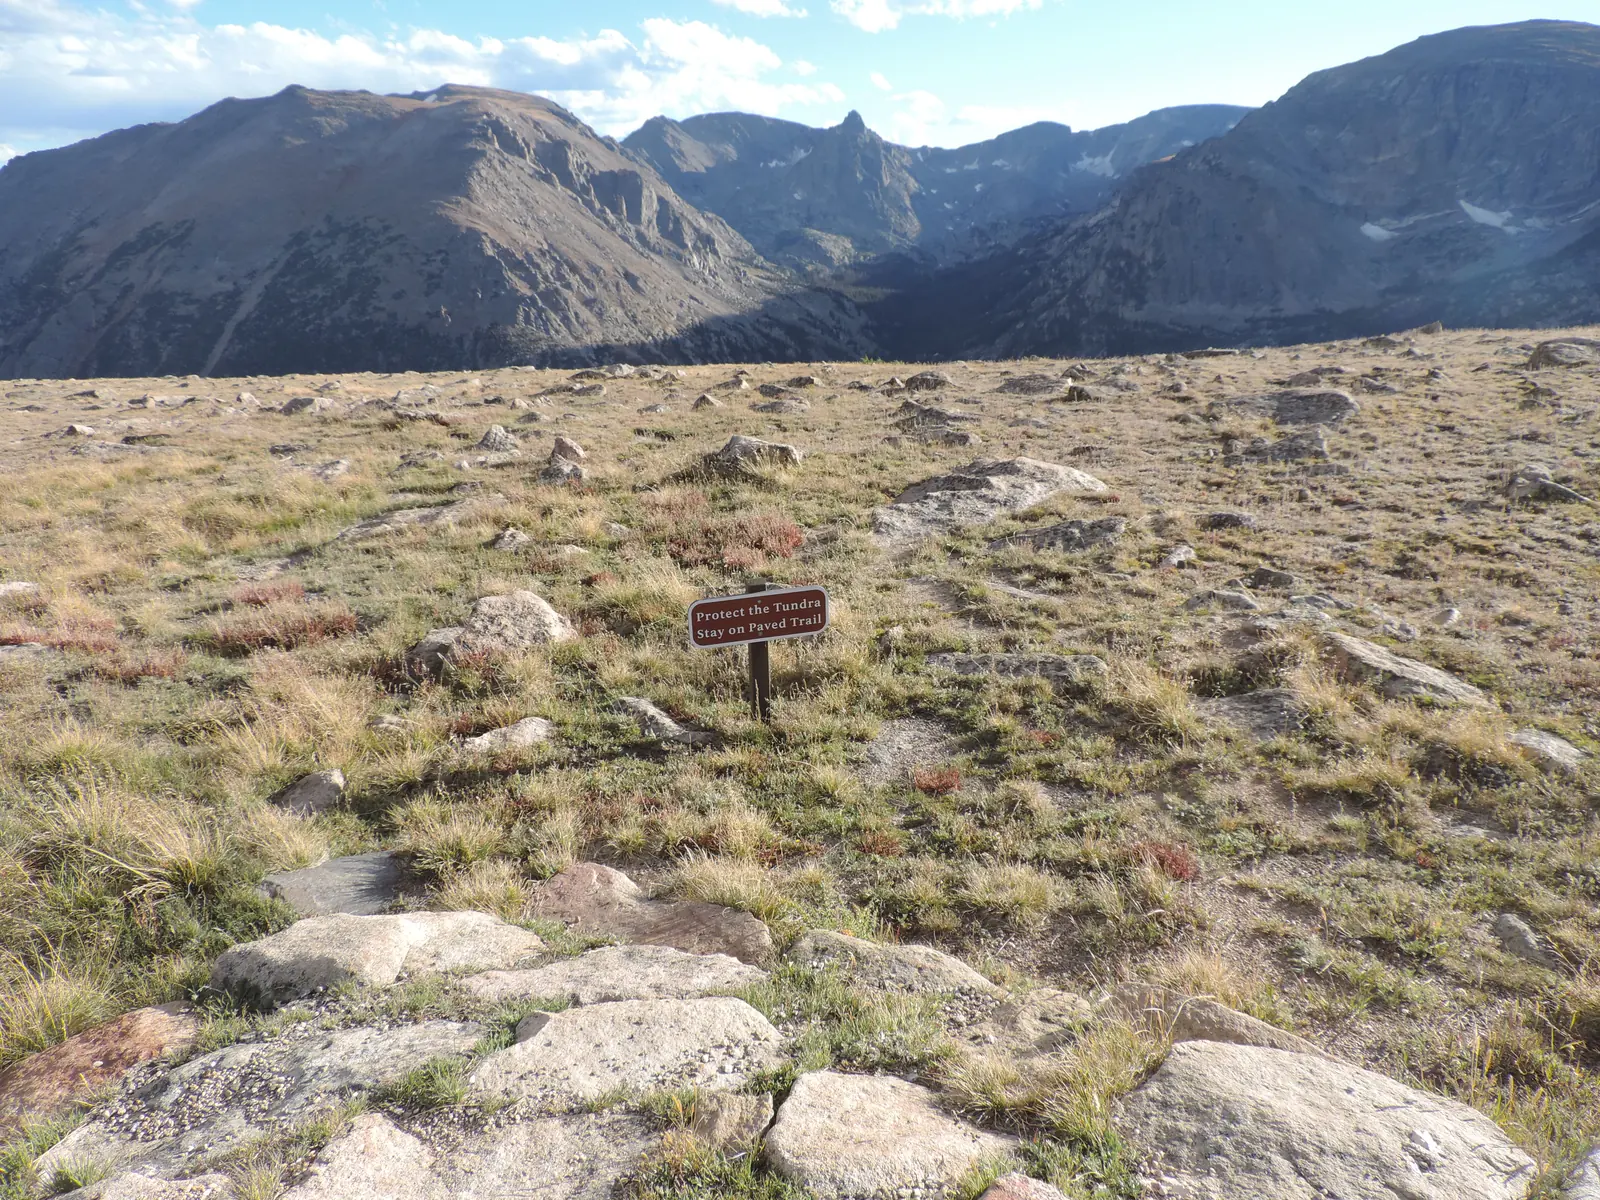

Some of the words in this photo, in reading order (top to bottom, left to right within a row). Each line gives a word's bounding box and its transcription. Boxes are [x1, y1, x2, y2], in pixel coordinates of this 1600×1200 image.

[696, 607, 745, 622] Protect
[749, 604, 770, 616] the
[773, 598, 821, 613] Tundra
[697, 628, 725, 639] Stay
[728, 626, 745, 635] on
[749, 618, 787, 632] Paved
[790, 614, 822, 627] Trail
